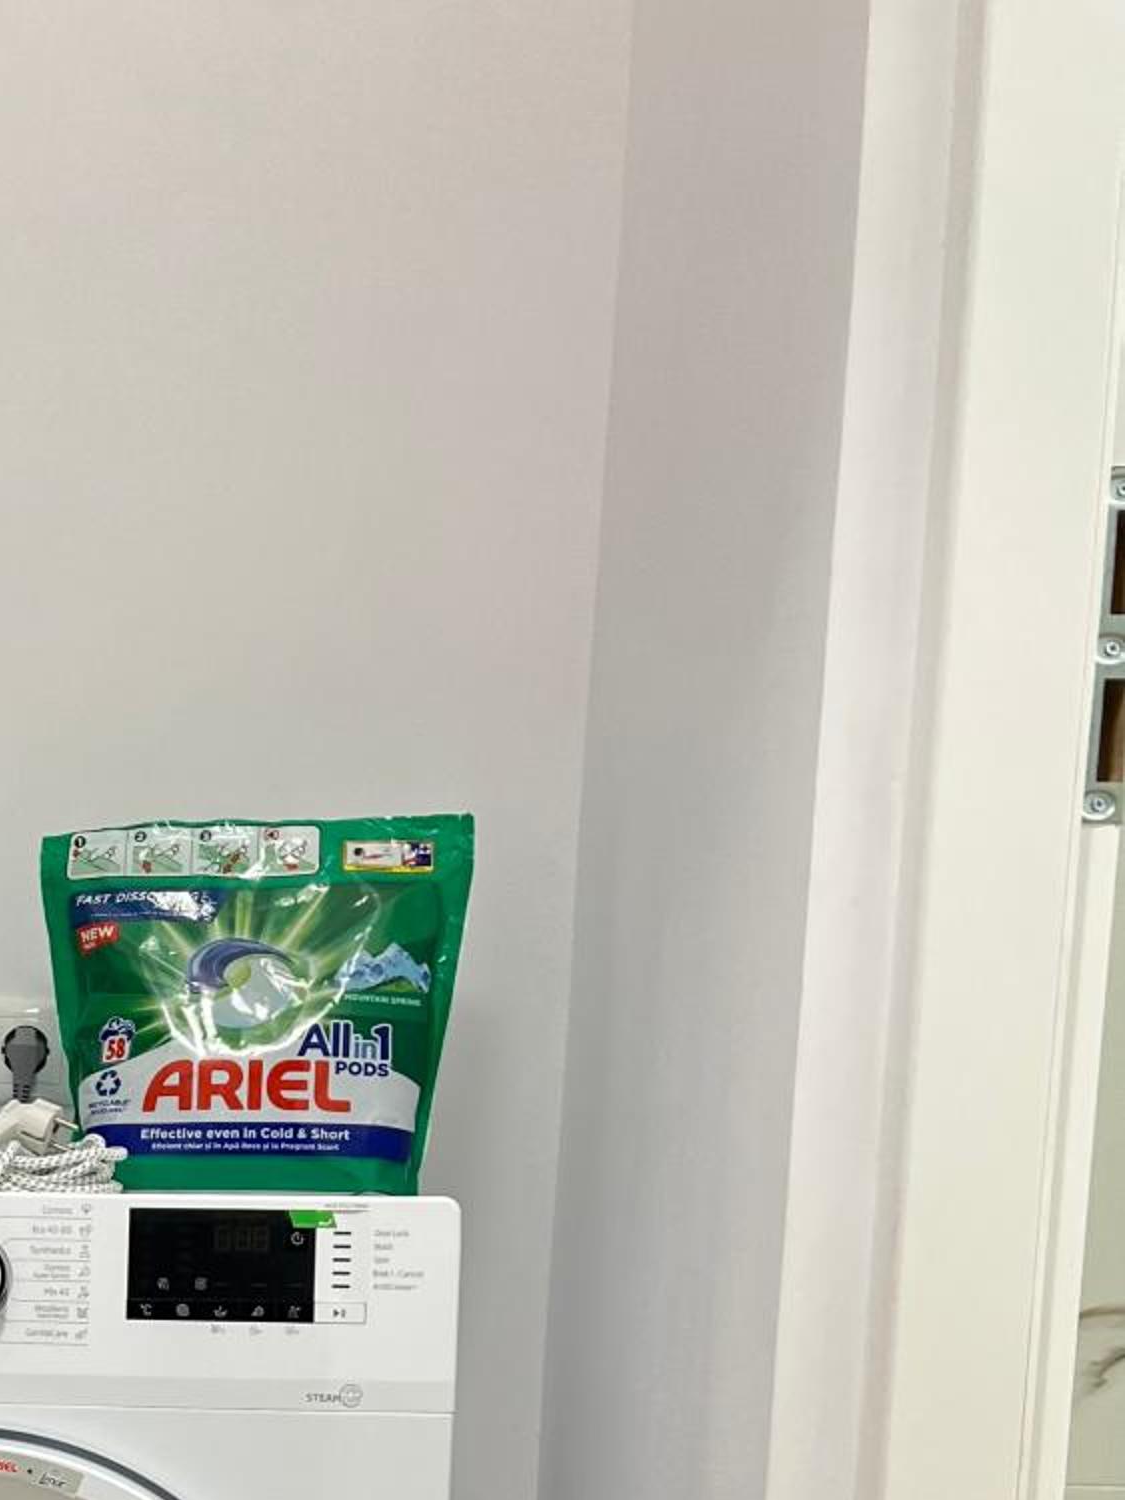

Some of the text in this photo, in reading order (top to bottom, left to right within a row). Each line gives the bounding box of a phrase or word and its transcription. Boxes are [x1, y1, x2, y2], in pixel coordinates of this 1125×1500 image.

[76, 894, 112, 906] FAST
[81, 925, 114, 942] NEW
[106, 1038, 125, 1060] 58
[335, 1061, 389, 1077] PODS
[142, 1059, 352, 1113] ARIEL
[140, 1126, 350, 1141] Effective even in Cold & Short
[306, 1392, 342, 1403] STEAM
